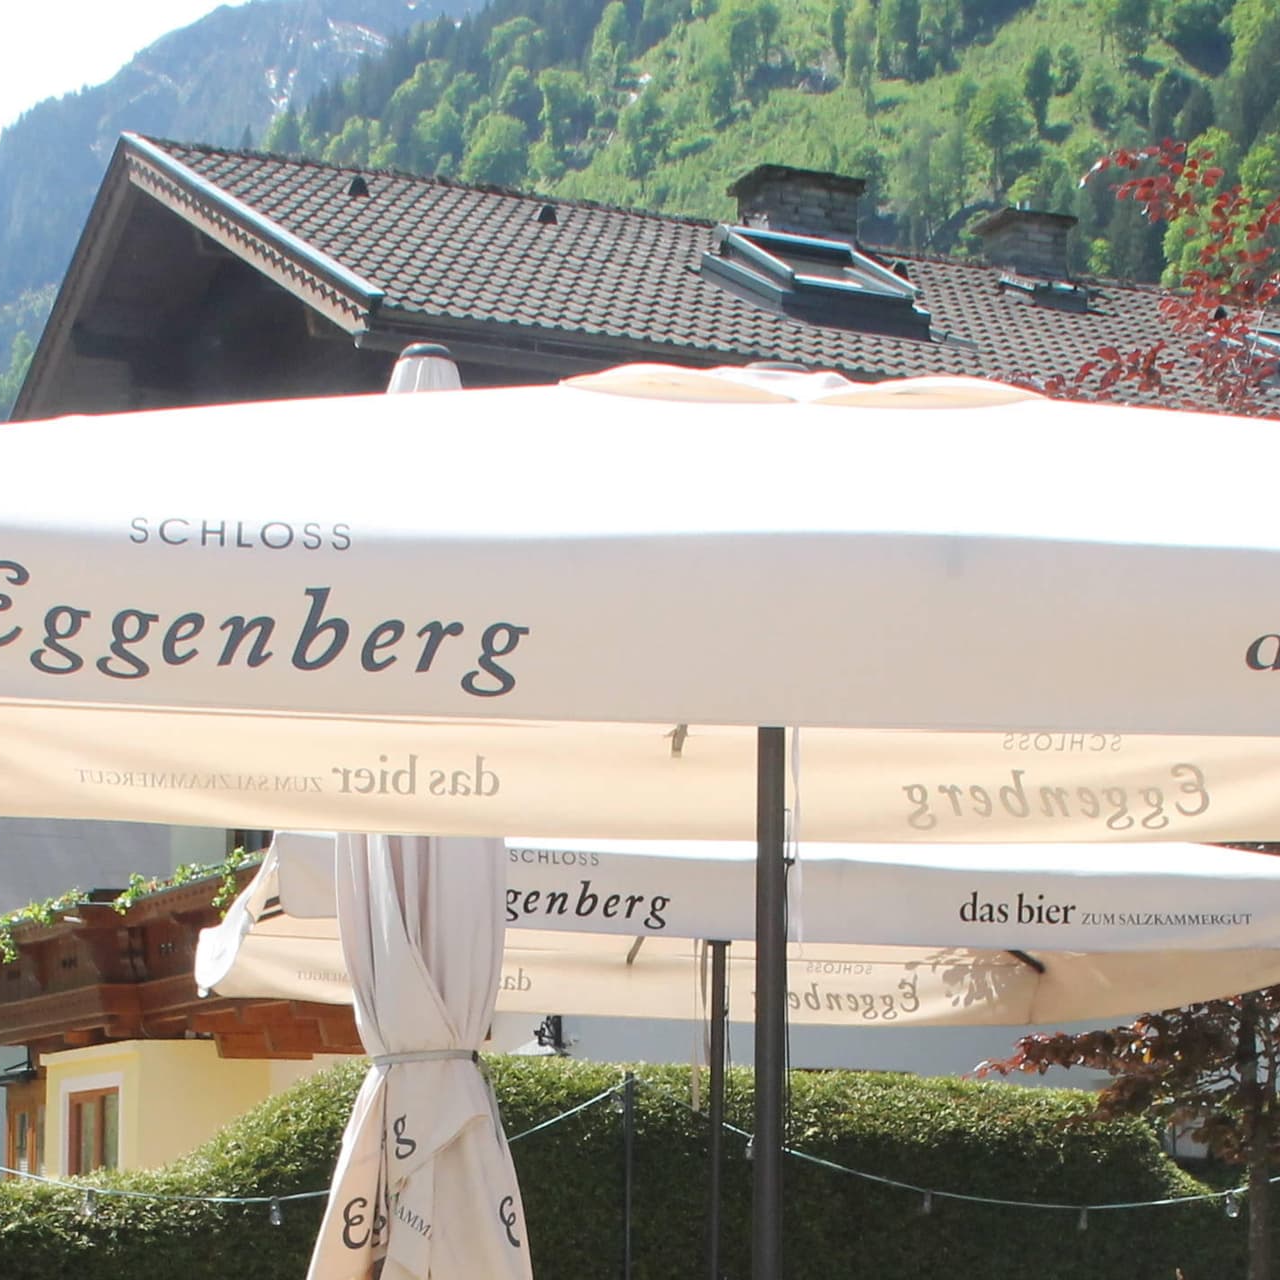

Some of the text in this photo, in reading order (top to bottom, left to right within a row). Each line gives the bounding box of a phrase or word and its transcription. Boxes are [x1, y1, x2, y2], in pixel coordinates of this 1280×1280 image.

[129, 517, 353, 551] SCHLOSS
[510, 849, 600, 866] SCHLOSS
[506, 880, 671, 930] genberg
[959, 891, 1252, 926] das bier ZUM SALZKAMMERGUT
